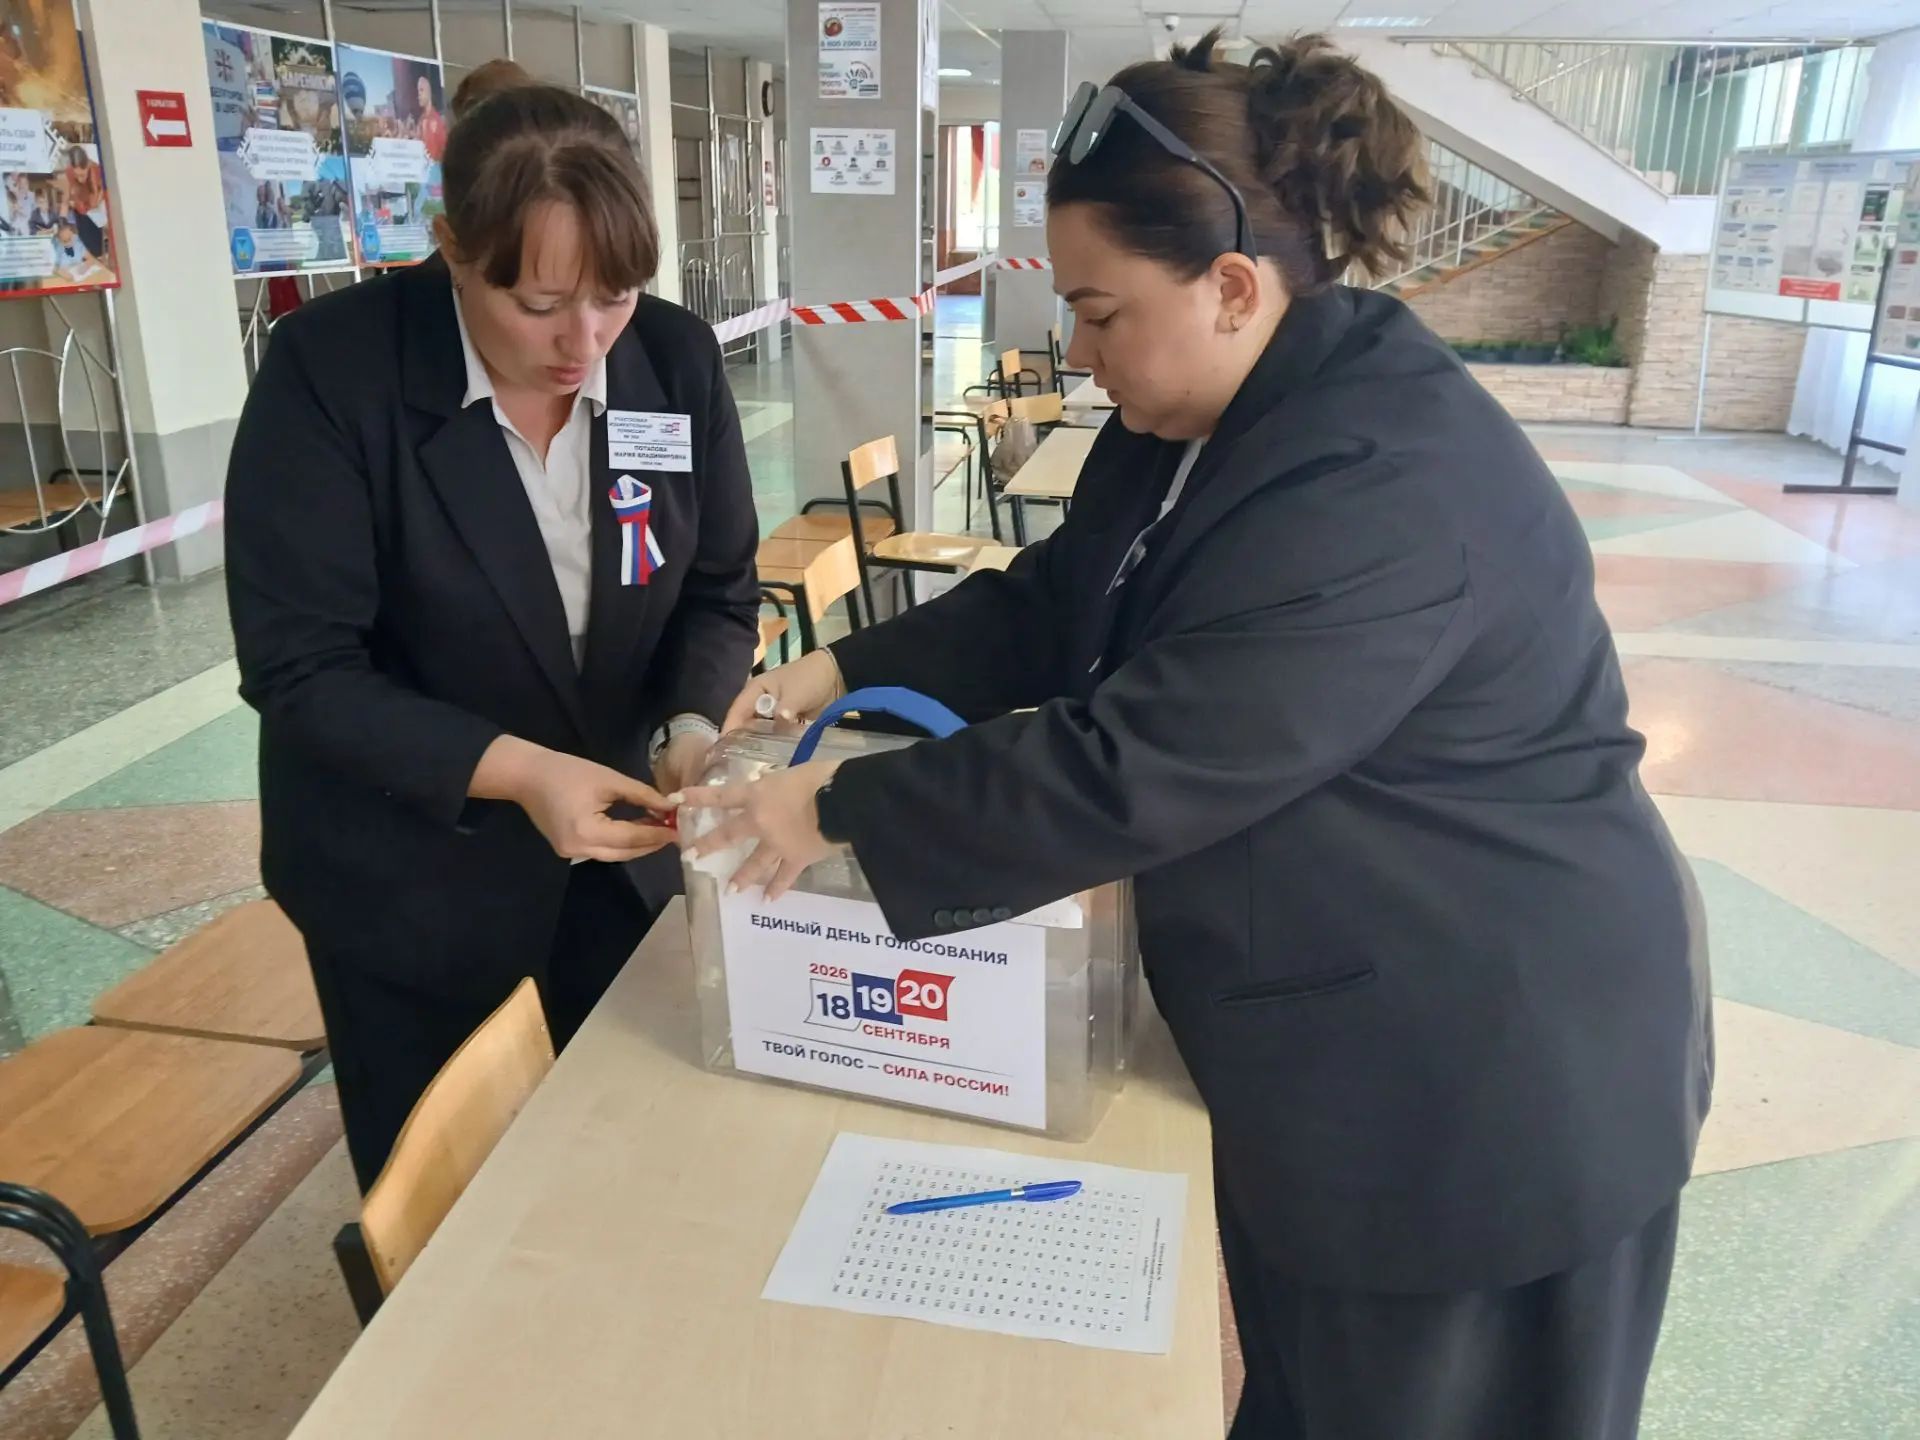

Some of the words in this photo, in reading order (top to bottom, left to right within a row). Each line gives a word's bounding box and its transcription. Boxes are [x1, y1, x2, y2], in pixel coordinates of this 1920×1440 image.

[751, 913, 822, 937] ЕДИНЫЙ
[826, 927, 871, 945] ДЕНЬ
[875, 935, 1008, 965] ГОЛОСОВАНИЯ
[809, 963, 848, 980] 2026
[816, 992, 851, 1020] 18
[856, 985, 892, 1014] 19
[899, 979, 945, 1011] 20
[862, 1023, 951, 1049] СЕНТЯБРЯ
[762, 1040, 806, 1060] ТВОЙ
[810, 1050, 864, 1070] ГОЛОС
[883, 1062, 929, 1082] СИЛА
[934, 1072, 1010, 1097] РОССИИ!
